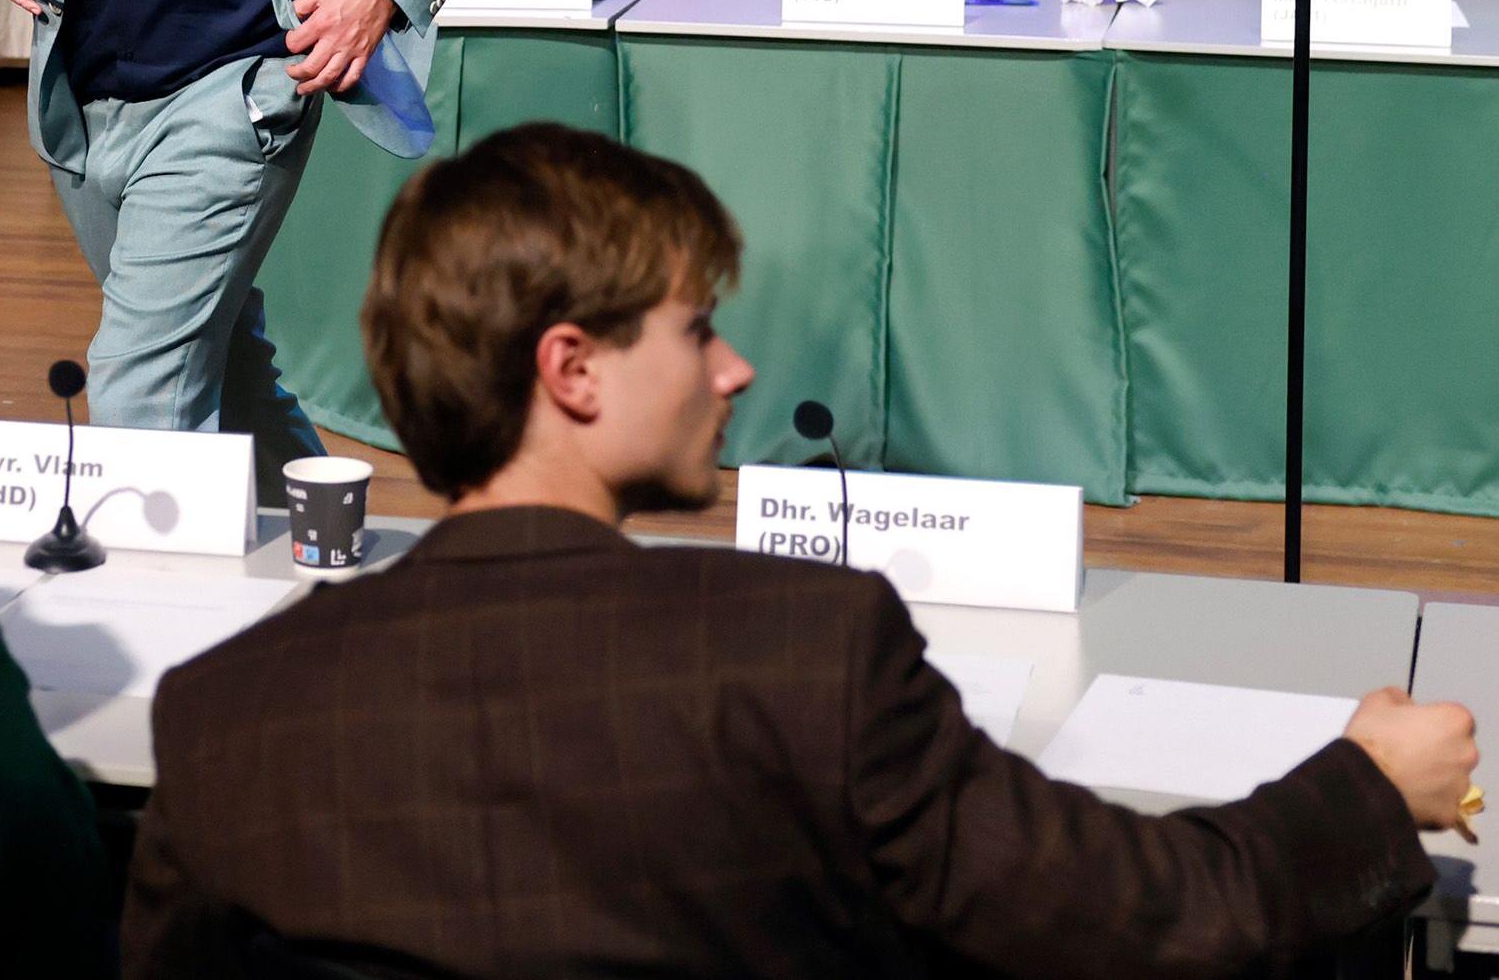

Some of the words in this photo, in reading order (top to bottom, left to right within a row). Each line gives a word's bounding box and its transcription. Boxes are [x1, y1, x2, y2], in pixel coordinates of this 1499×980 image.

[34, 454, 104, 477] Vlam
[760, 497, 817, 521] Dhr.
[828, 502, 970, 532] Wagelaar
[758, 531, 842, 564] (PRO)
